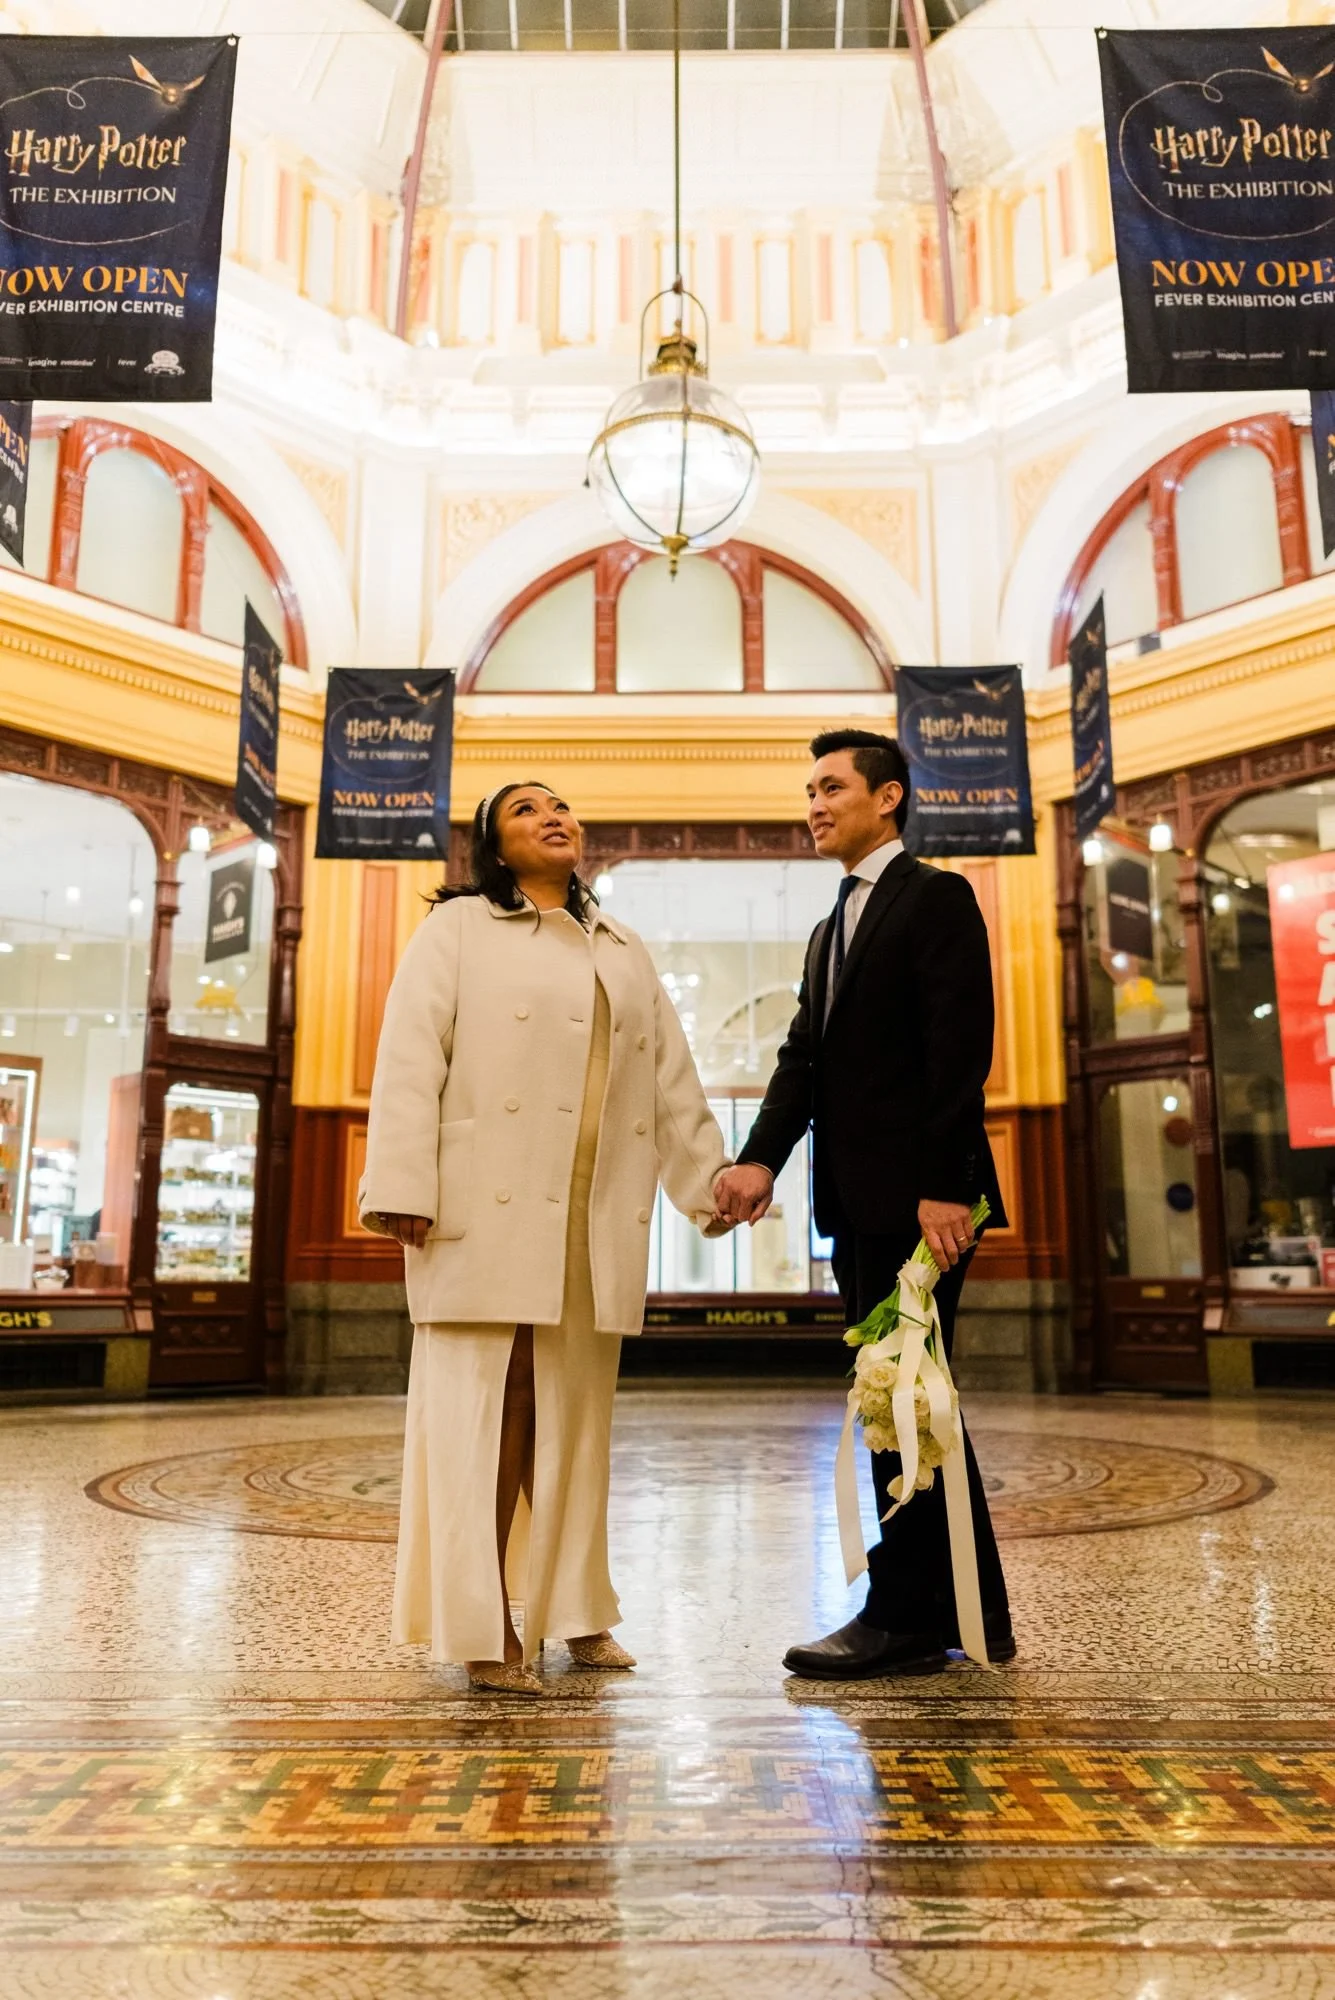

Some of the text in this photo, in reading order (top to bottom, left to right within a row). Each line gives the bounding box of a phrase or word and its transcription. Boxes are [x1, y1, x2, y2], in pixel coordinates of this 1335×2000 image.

[4, 124, 187, 178] Harry Potter
[1150, 117, 1332, 174] Harry Potter
[9, 186, 177, 205] THE EXHIBITION
[1163, 179, 1334, 199] THE EXHIBITION
[0, 265, 189, 298] OW OPEN
[1151, 259, 1247, 288] NOW
[29, 299, 118, 314] EXHIBITION
[121, 300, 185, 318] CENTRE
[1154, 290, 1335, 308] FEVER EXHIBITION CEN
[344, 715, 434, 747] Harry Potter
[917, 712, 1009, 745] Harry Potter
[332, 789, 435, 808] NOW OPEN
[916, 786, 1019, 804] NOW OPEN
[706, 1310, 789, 1325] HAIGH'S
